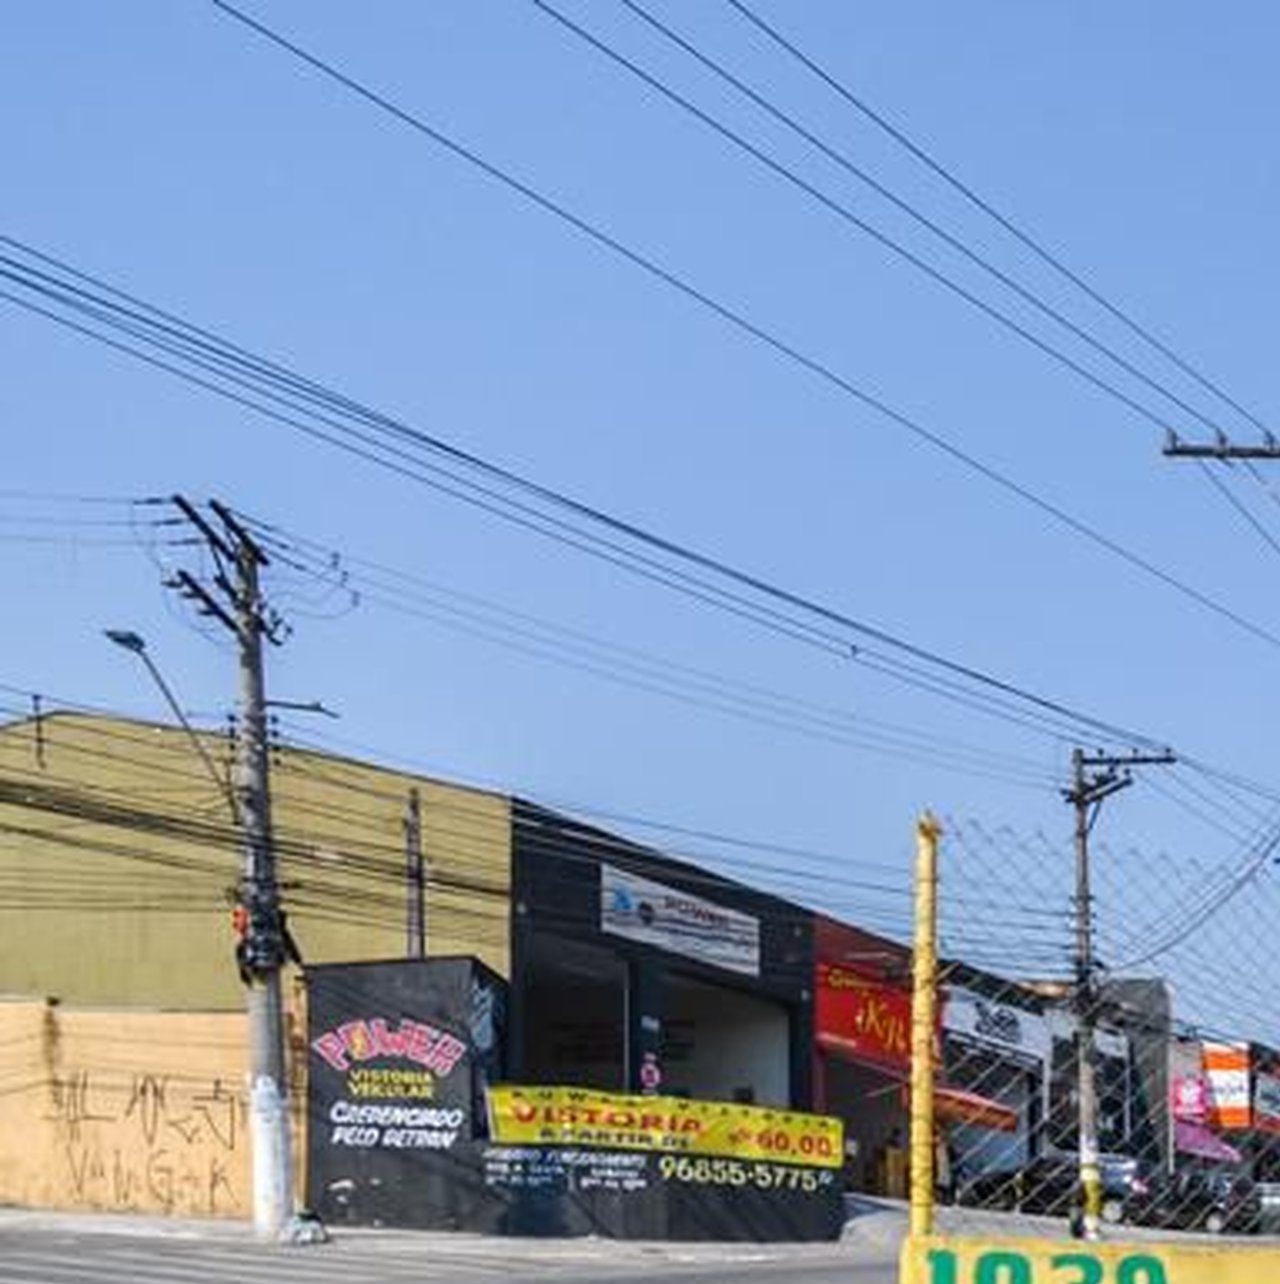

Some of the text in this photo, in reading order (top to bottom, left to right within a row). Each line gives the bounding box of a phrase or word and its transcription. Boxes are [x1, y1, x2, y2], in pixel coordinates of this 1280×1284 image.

[311, 1017, 467, 1078] POWER
[350, 1069, 434, 1084] VISTORIA
[347, 1081, 434, 1098] VEICULAR
[511, 1102, 703, 1134] VISTORIA
[331, 1124, 458, 1149] PELO DETRAN
